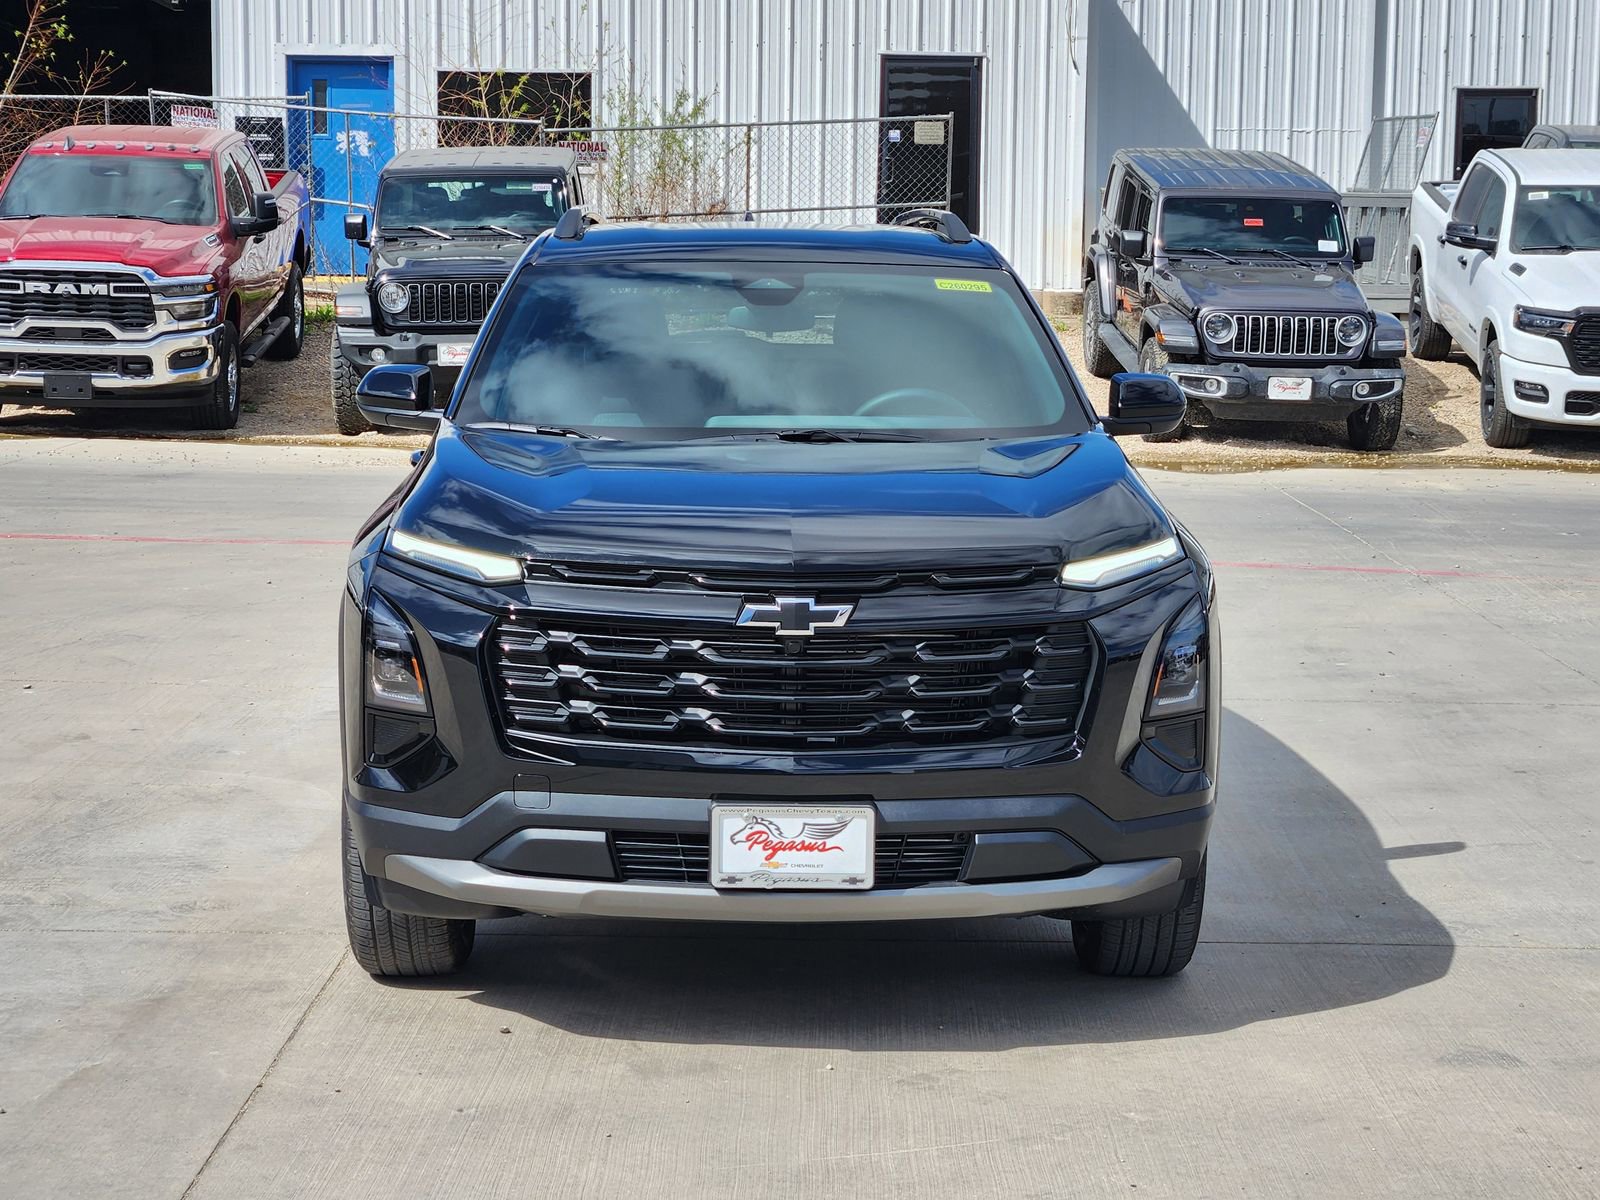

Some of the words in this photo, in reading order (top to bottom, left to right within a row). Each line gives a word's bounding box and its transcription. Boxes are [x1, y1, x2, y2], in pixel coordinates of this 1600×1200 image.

[172, 105, 218, 120] NATIONAL
[559, 142, 606, 152] NATIONAL
[24, 281, 108, 295] RAM
[939, 282, 988, 291] C260295
[719, 807, 866, 815] www.PegasusChevyTexas.com
[745, 830, 844, 861] Pegasus
[749, 871, 833, 887] Pegasus
